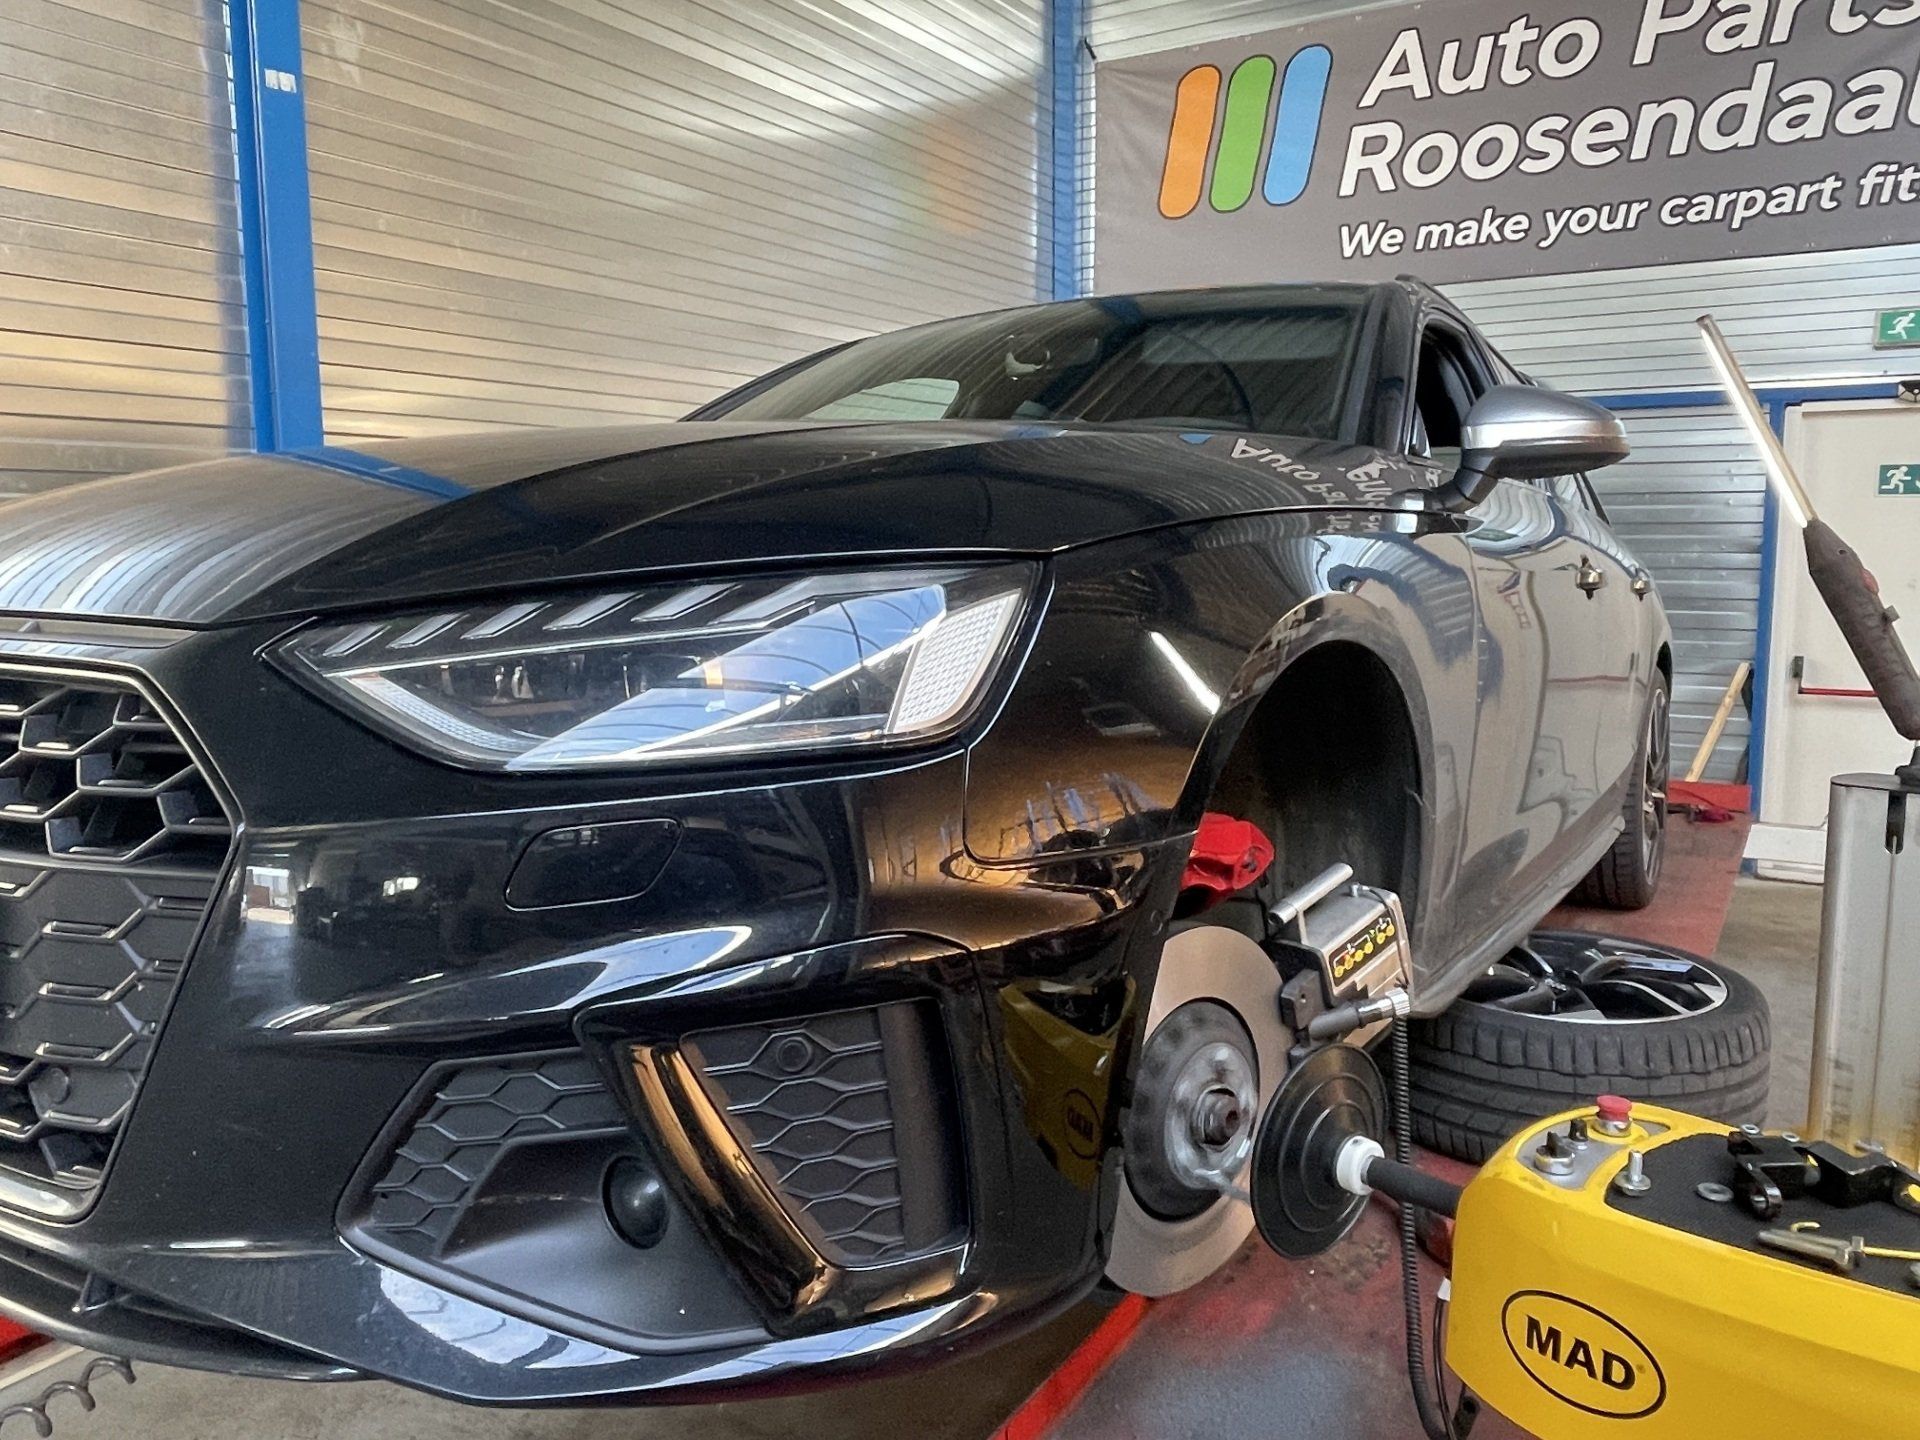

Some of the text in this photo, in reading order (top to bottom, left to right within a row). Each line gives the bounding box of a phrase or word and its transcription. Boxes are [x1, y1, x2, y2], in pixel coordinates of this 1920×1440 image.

[1357, 14, 1601, 108] Auto
[1340, 221, 1404, 258] We
[1415, 207, 1530, 250] make
[1538, 200, 1648, 248] your
[1660, 175, 1842, 230] carpart
[1526, 1314, 1636, 1391] MAD
